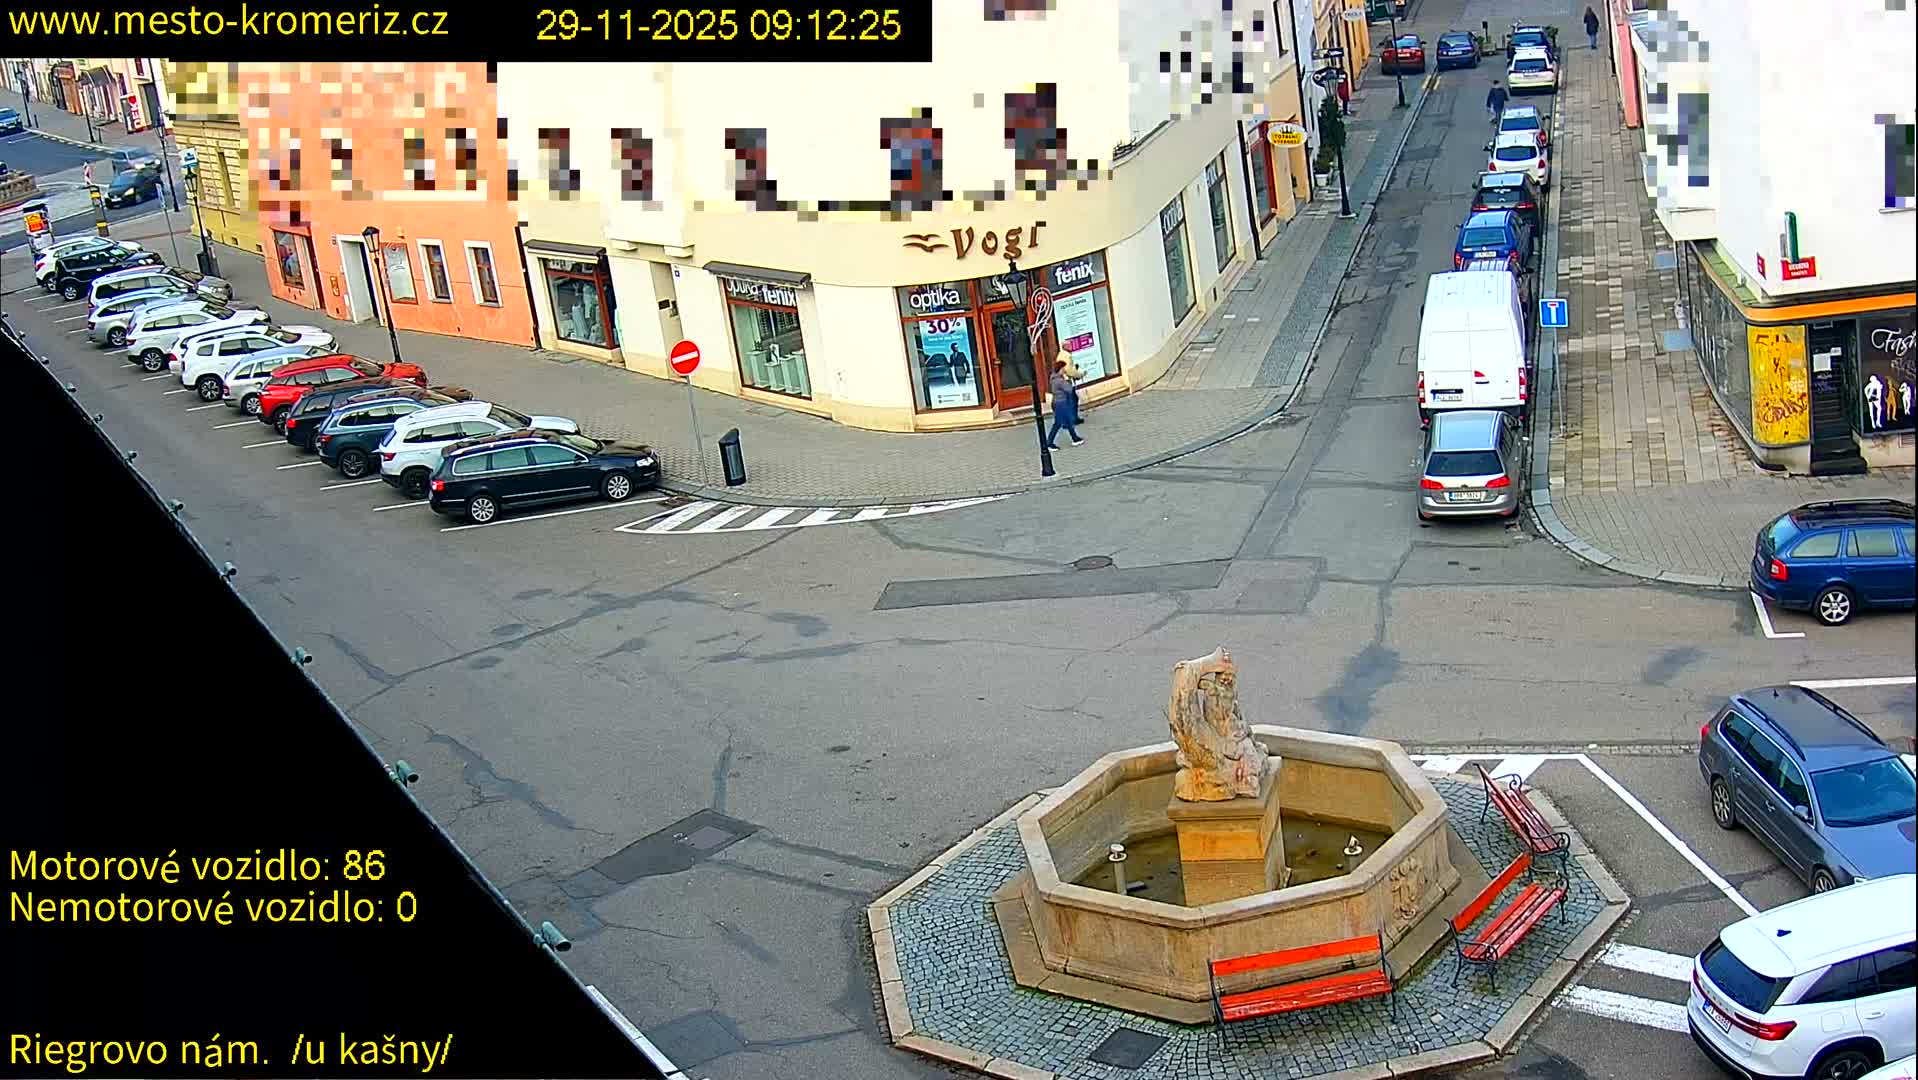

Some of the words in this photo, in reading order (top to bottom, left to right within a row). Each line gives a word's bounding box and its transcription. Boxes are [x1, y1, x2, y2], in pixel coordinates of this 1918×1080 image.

[1055, 261, 1094, 285] fenix
[761, 284, 797, 307] fenix
[910, 287, 961, 312] optika
